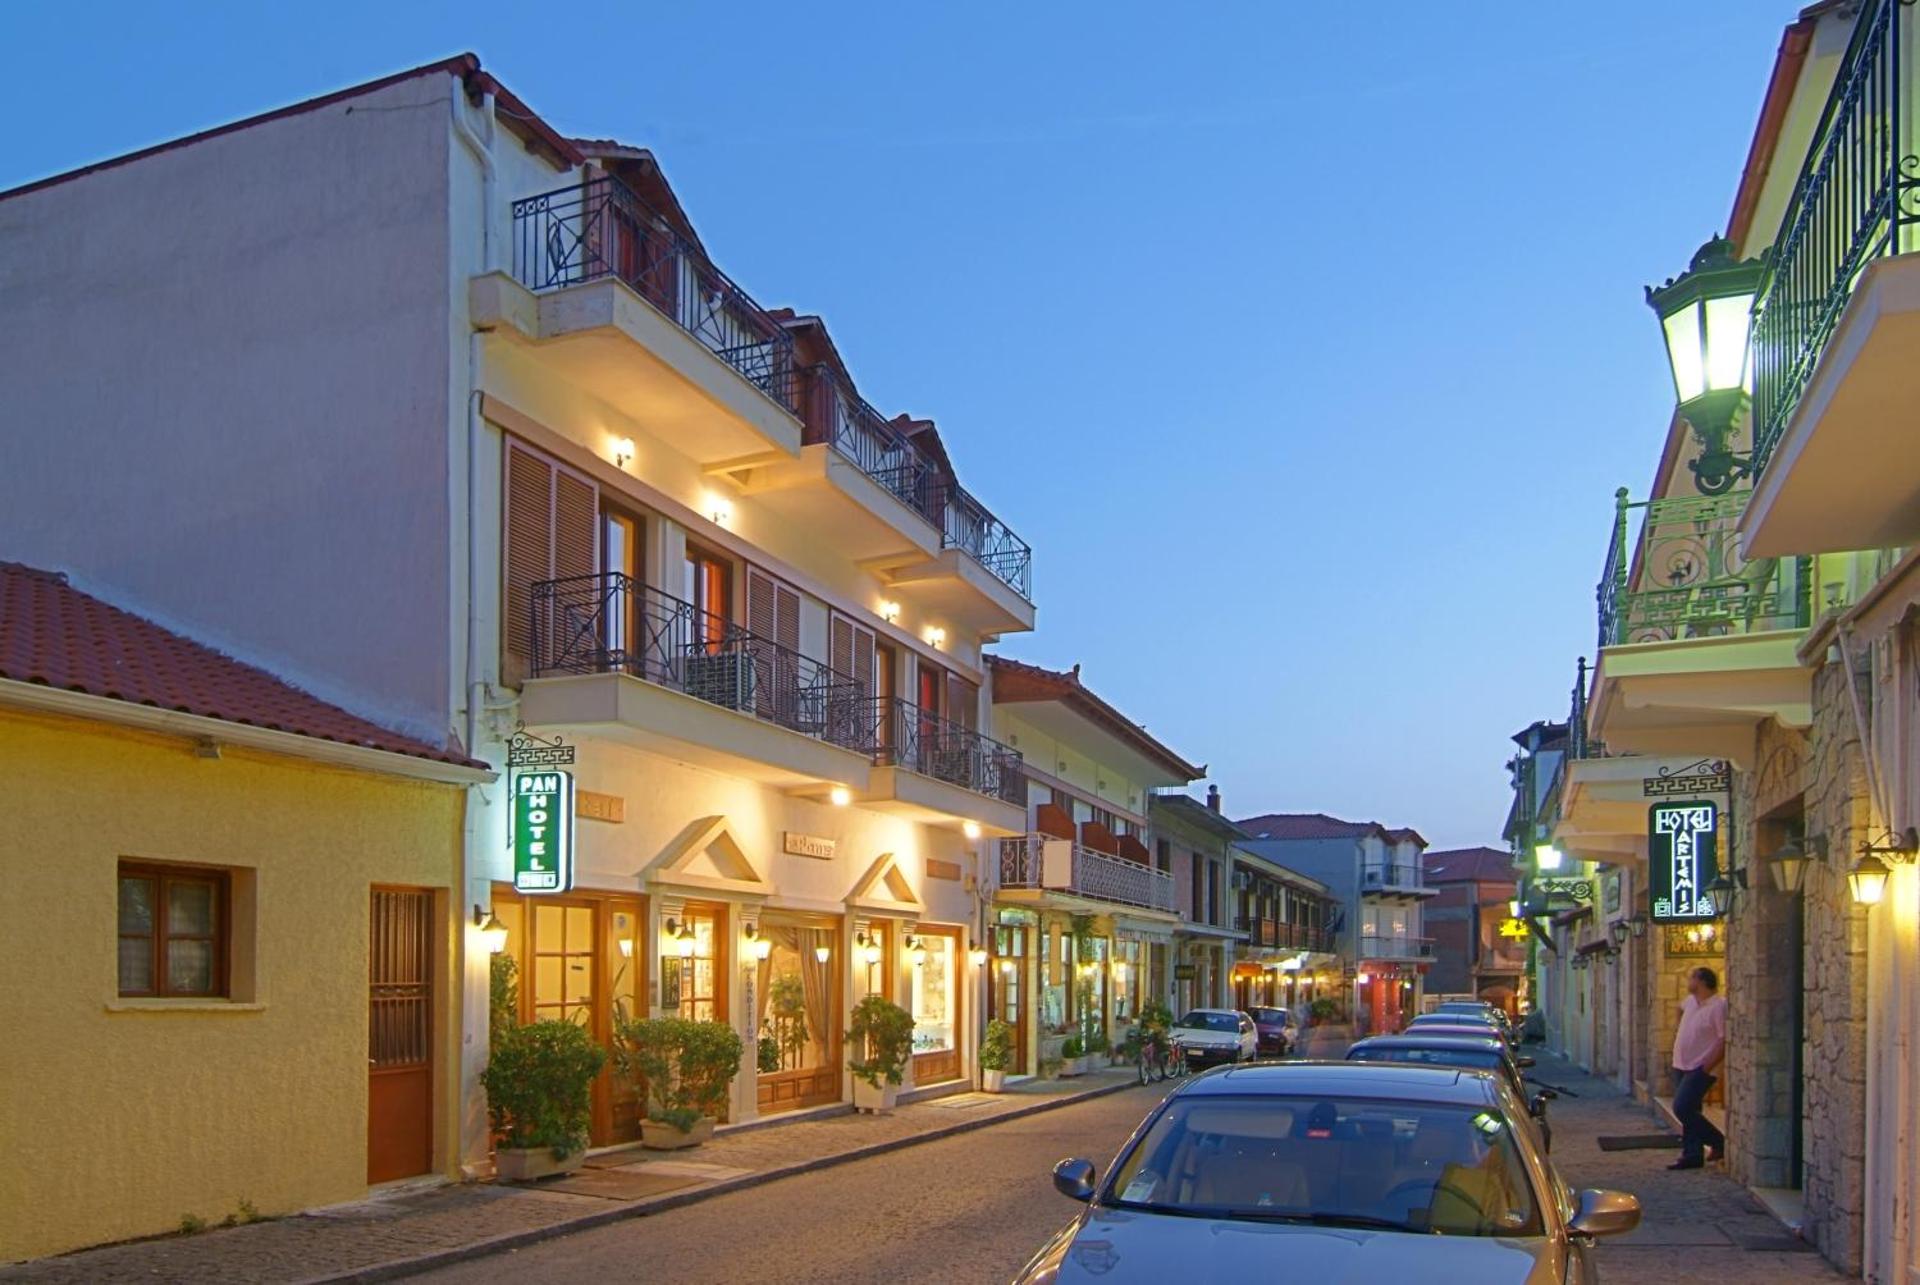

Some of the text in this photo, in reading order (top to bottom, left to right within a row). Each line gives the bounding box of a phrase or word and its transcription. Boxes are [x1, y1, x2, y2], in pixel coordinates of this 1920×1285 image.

[520, 776, 557, 793] PAN
[529, 795, 547, 870] HOTEL
[1657, 808, 1711, 830] HOTEL
[1675, 831, 1692, 913] ARTEMIS
